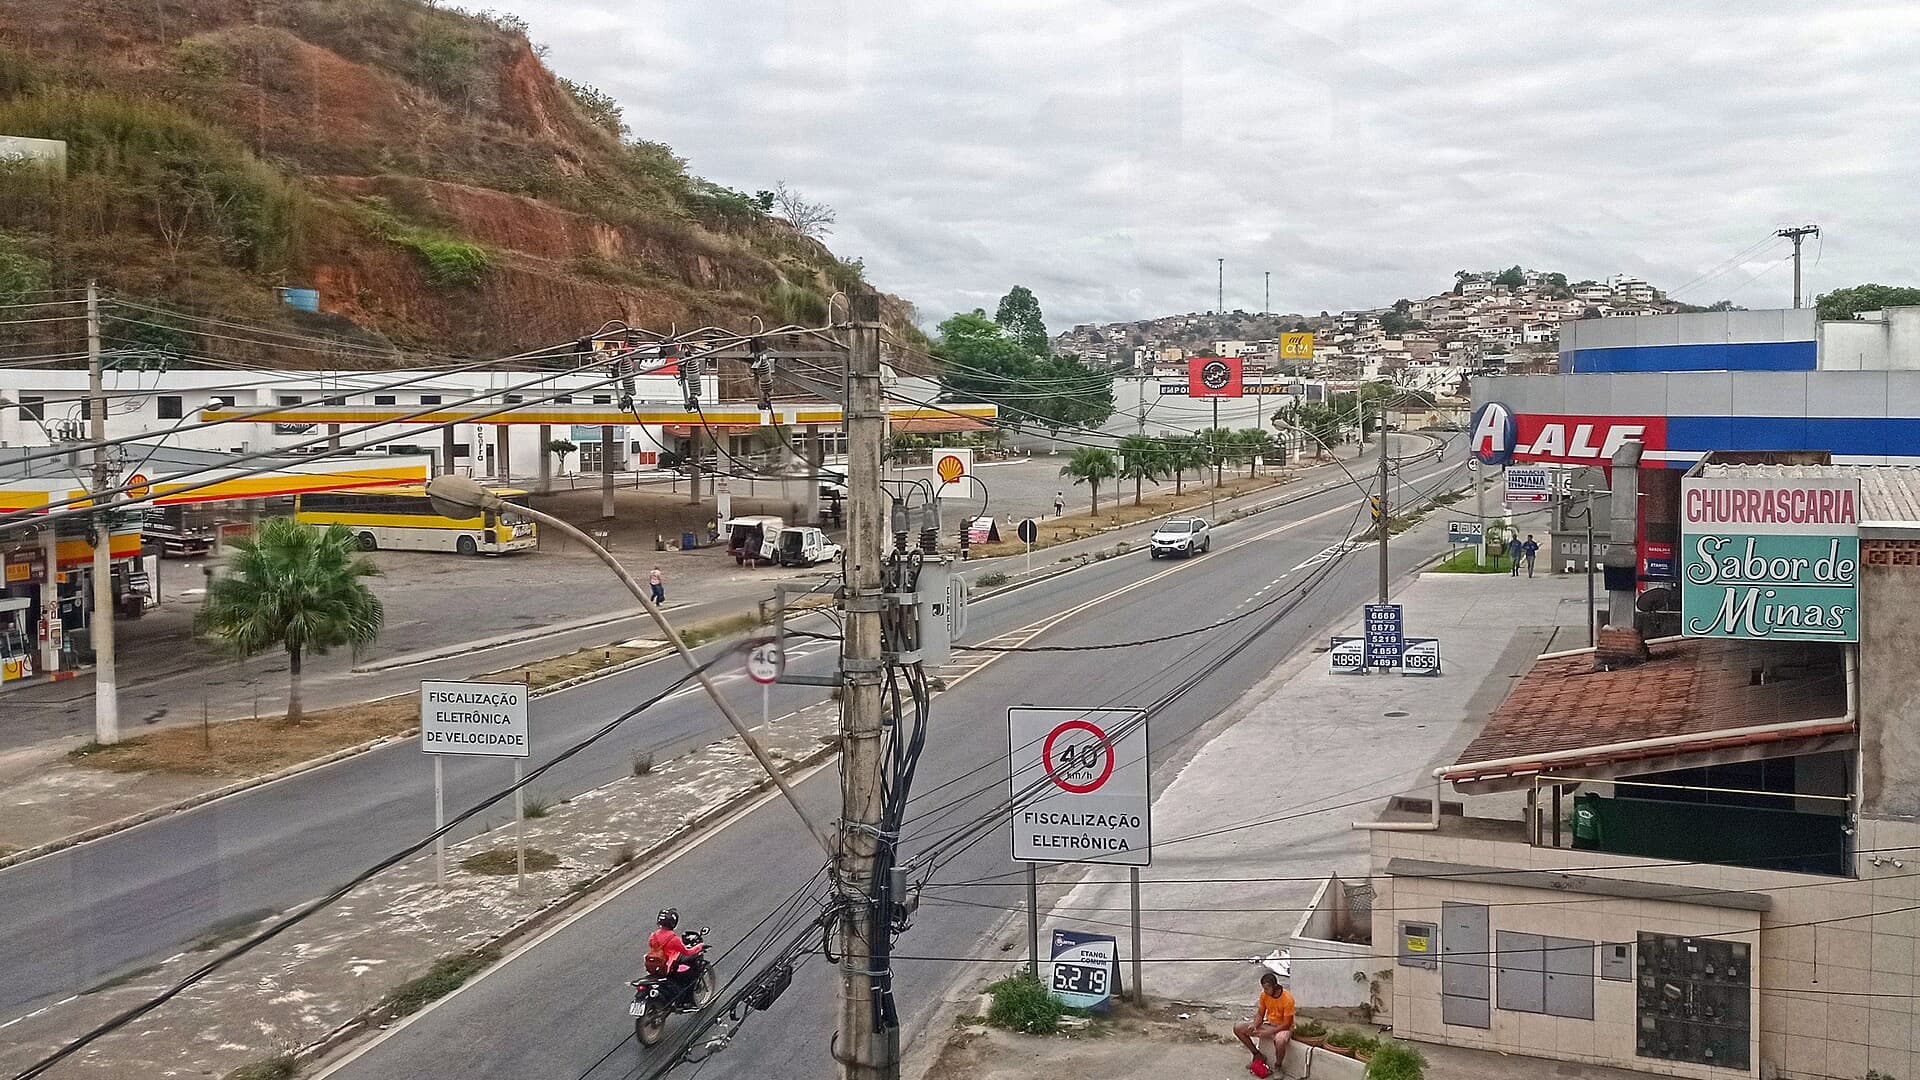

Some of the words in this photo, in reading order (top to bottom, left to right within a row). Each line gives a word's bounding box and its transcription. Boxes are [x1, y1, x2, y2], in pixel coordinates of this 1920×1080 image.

[1242, 384, 1288, 394] GOODYE
[1508, 476, 1546, 488] INDIANA
[1686, 488, 1856, 524] CHURRASCARIA
[1686, 534, 1809, 585] Sabor
[1814, 538, 1855, 582] de
[1688, 587, 1853, 637] Minas
[429, 691, 518, 707] FISCALIZAÇÃO
[436, 710, 511, 725] ELETRÔNICA
[427, 731, 443, 742] DE
[445, 732, 524, 746] VELOCIDADE
[1059, 744, 1099, 769] 40
[1066, 771, 1093, 780] km/h
[1024, 812, 1141, 830] FISCALIZAÇÃO
[1032, 833, 1130, 851] ELETRÔNICA
[1080, 950, 1108, 959] ETANOL
